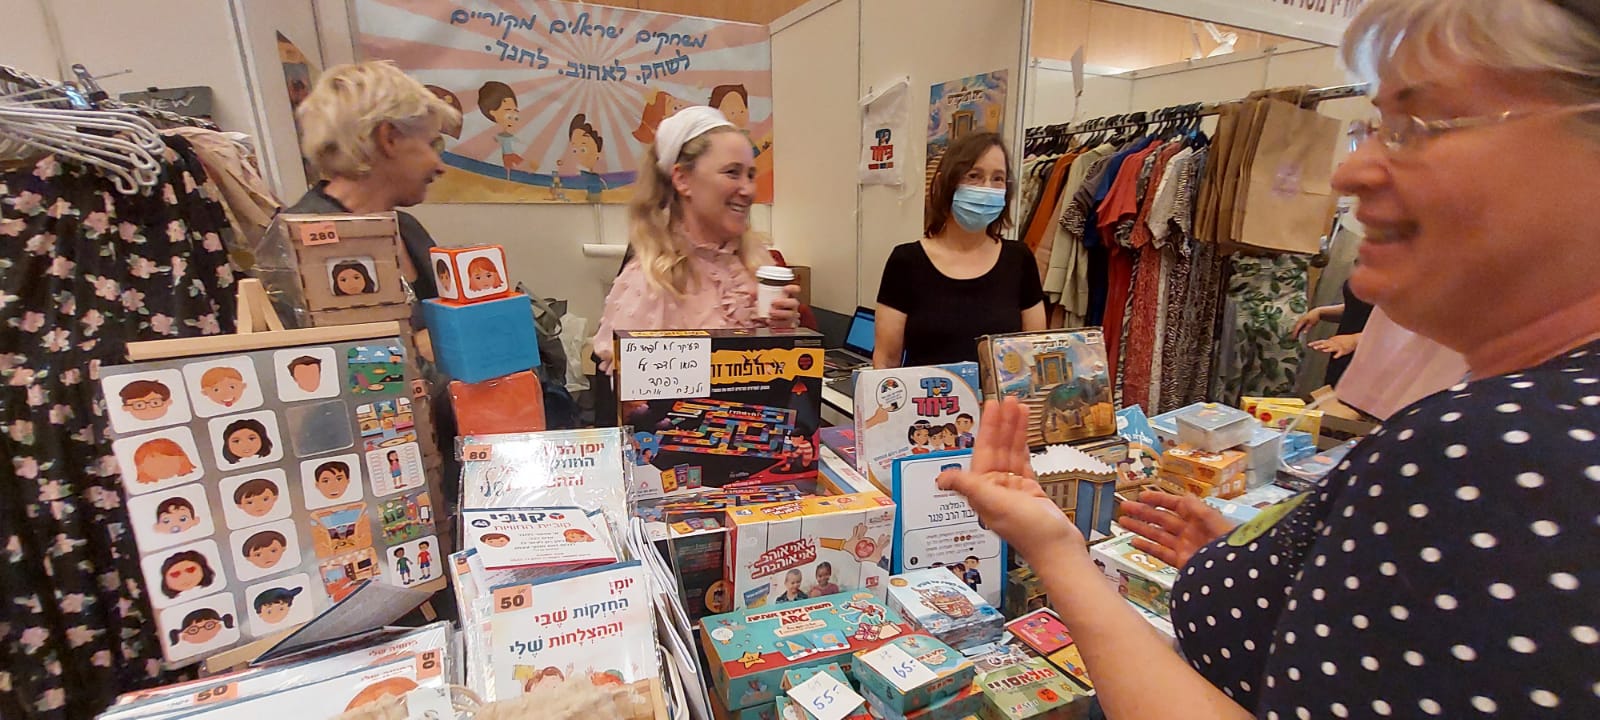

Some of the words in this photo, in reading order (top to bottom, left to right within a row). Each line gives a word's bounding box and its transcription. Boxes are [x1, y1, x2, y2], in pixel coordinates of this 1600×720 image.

[451, 9, 537, 39] מקוריים
[549, 12, 623, 39] ישראלים
[636, 30, 707, 54] משחקים
[485, 39, 550, 69] לחנך.
[558, 60, 626, 82] לאהוב.
[636, 49, 690, 84] לשחק.
[309, 231, 336, 242] 280
[725, 357, 753, 377] פחד
[920, 377, 952, 397] כיף
[912, 396, 960, 417] ביחד
[469, 450, 487, 460] 80
[791, 540, 805, 552] אני
[799, 546, 815, 560] אני
[500, 595, 524, 609] 50
[421, 651, 436, 670] 50
[197, 685, 229, 700] 50
